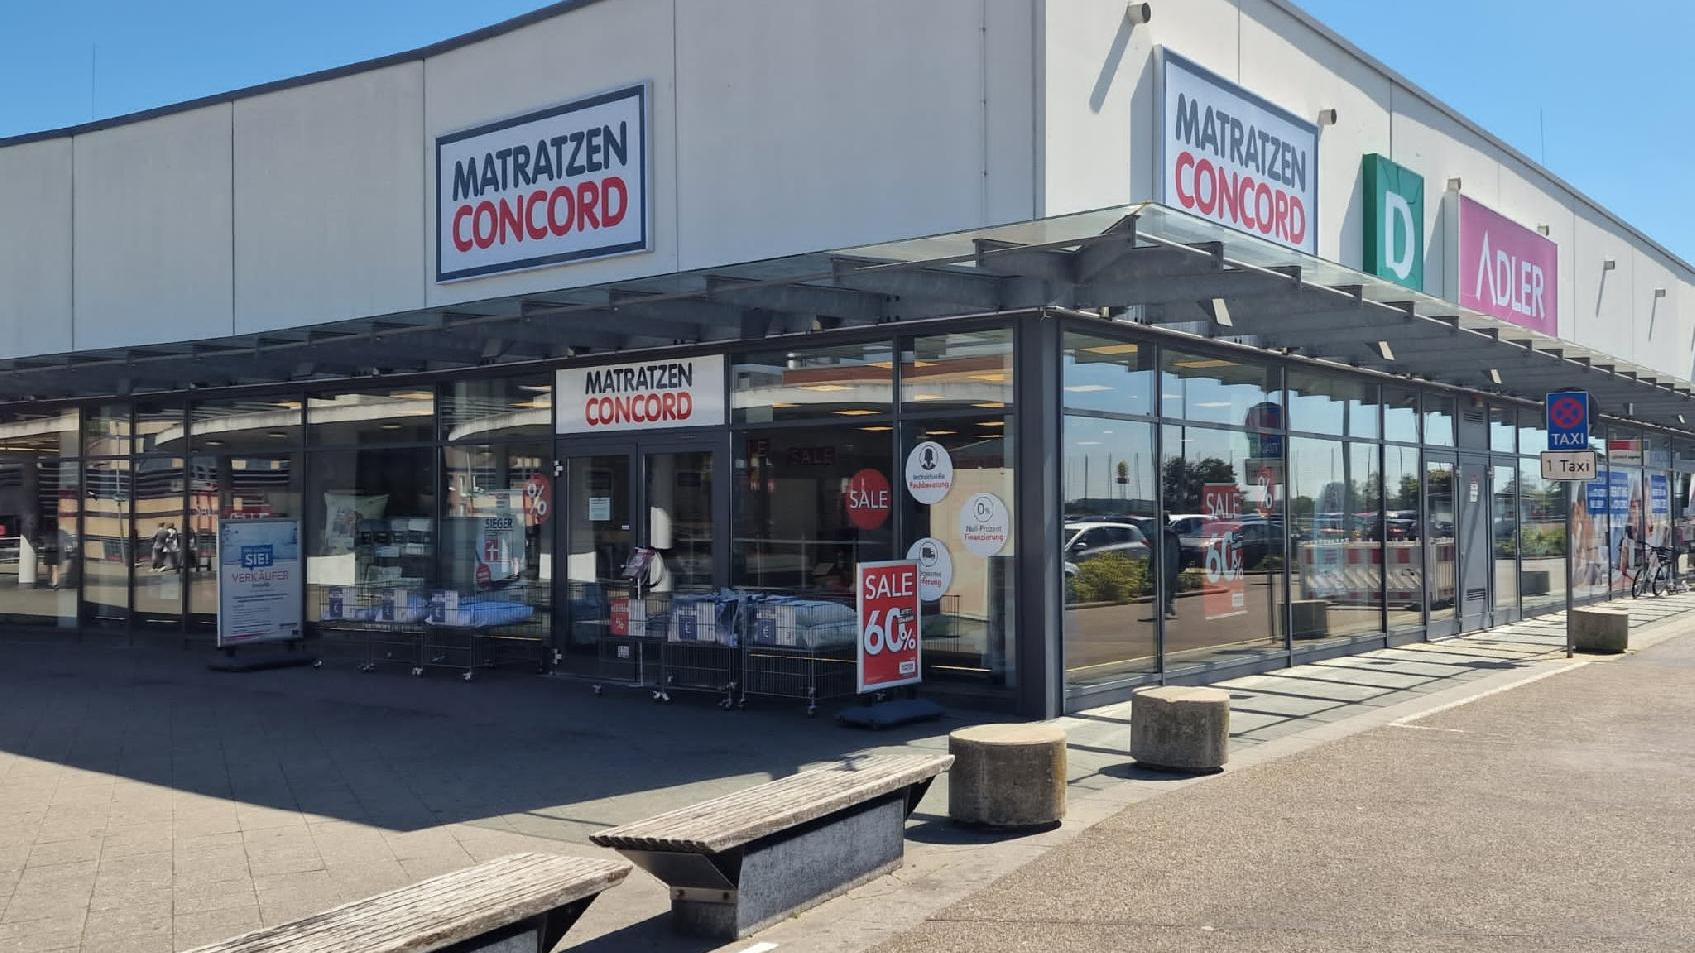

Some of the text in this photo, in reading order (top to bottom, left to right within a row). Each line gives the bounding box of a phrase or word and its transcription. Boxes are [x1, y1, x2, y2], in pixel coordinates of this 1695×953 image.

[1175, 93, 1306, 193] MATRATZEN
[453, 121, 628, 202] MATRATZEN
[453, 176, 628, 253] CONCORD
[1175, 152, 1306, 245] CONCORD
[1385, 190, 1415, 280] D
[1475, 229, 1546, 320] ADLER
[585, 362, 692, 395] MATRATZEN
[585, 392, 692, 426] CONCORD
[1551, 432, 1584, 446] TAXI
[1546, 459, 1590, 473] 1 Taxi
[527, 483, 548, 516] %
[850, 490, 889, 509] SALE
[1206, 491, 1240, 520] SALE
[484, 518, 513, 529] SIEGER
[244, 552, 270, 567] SIE!
[864, 571, 914, 601] SALE
